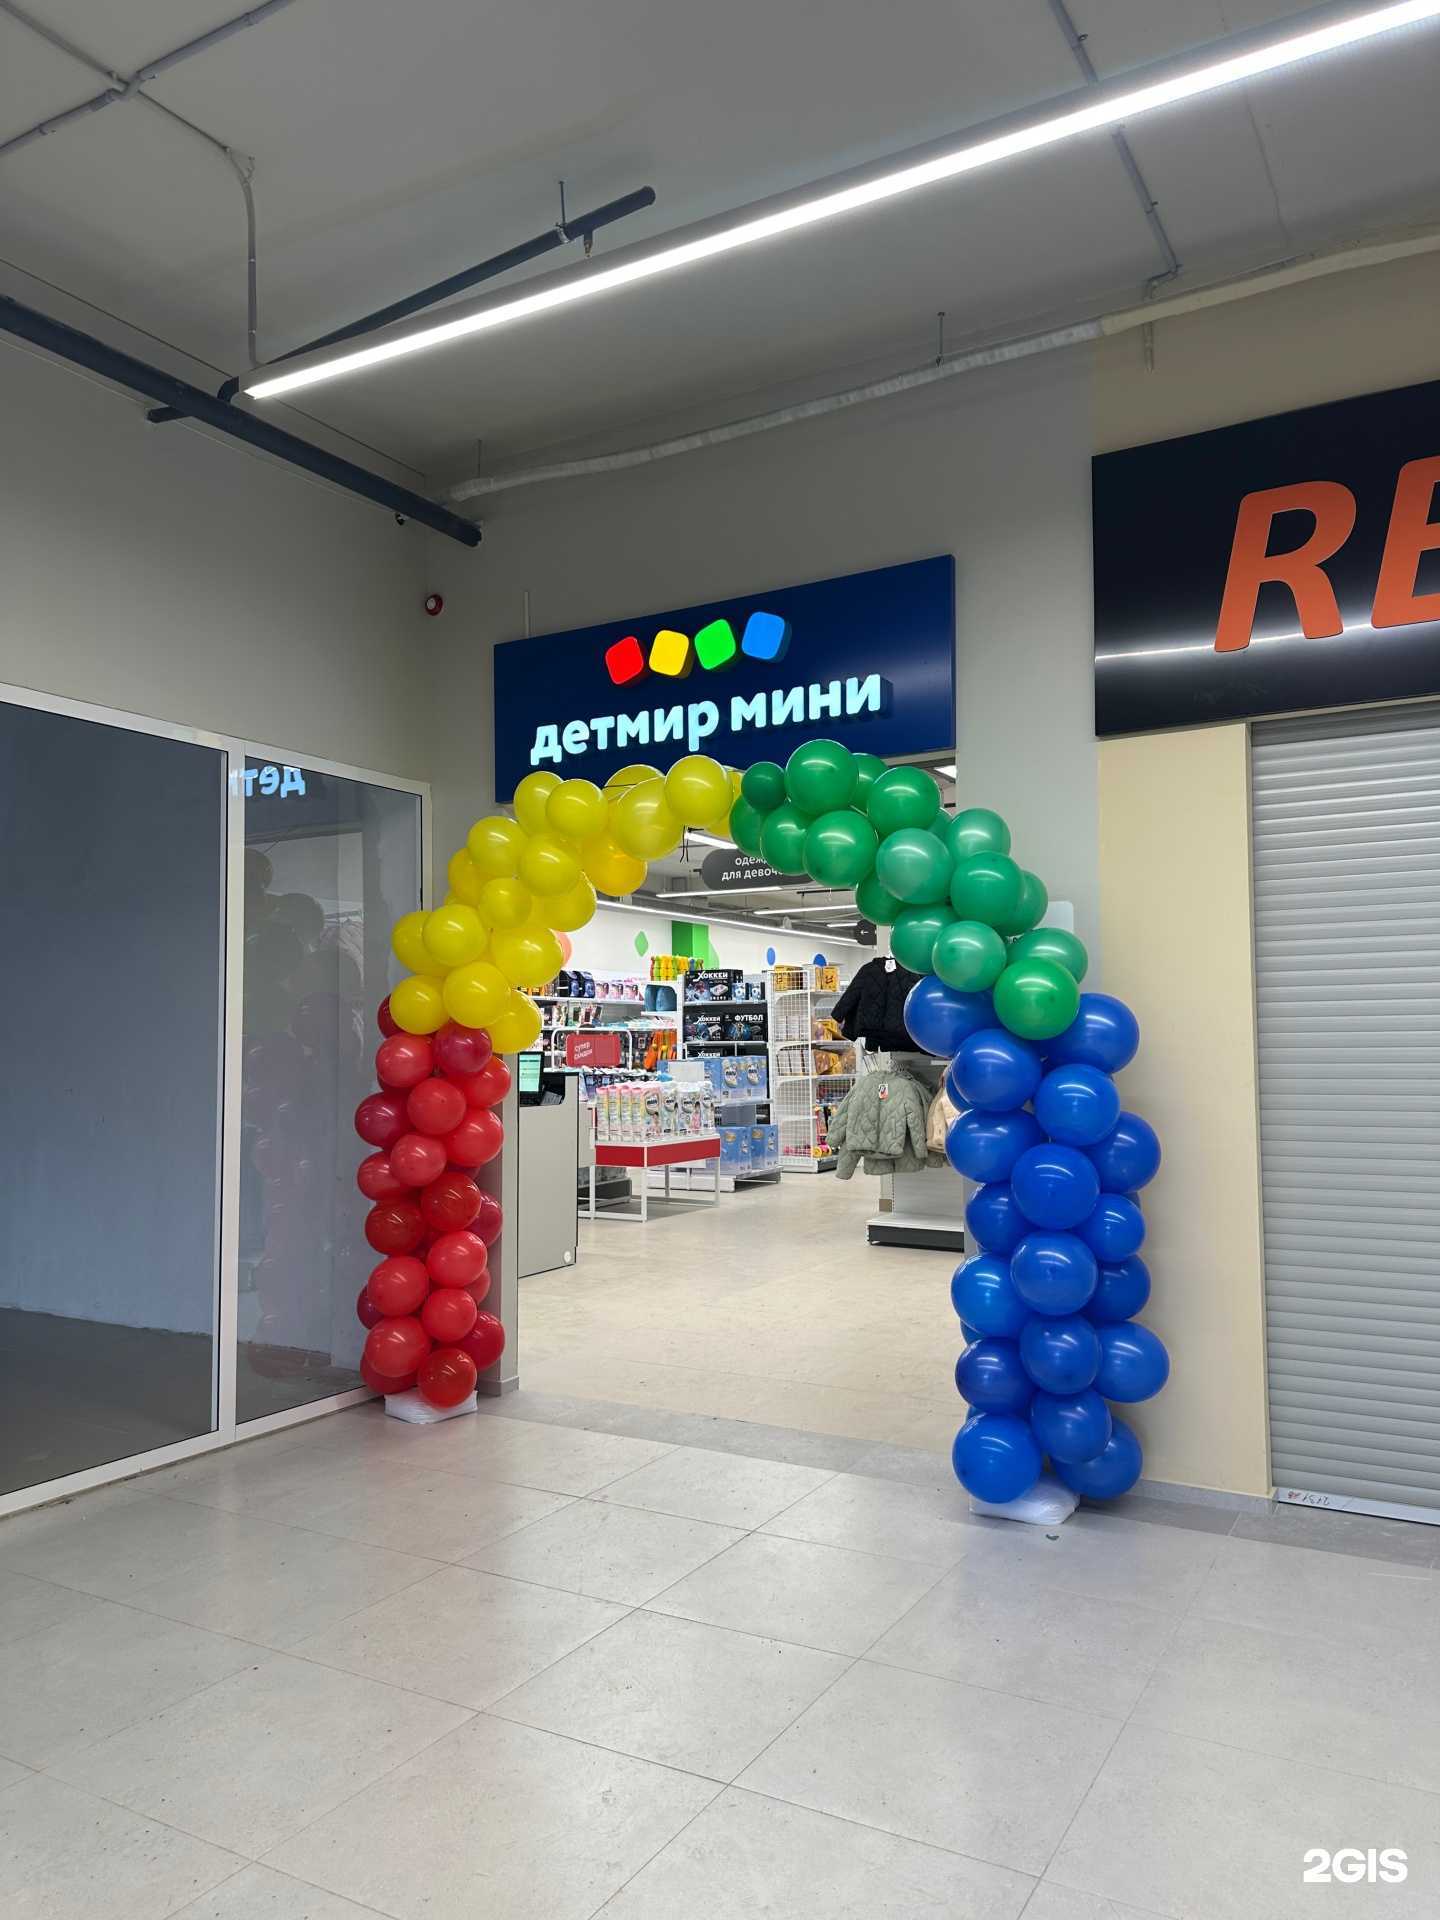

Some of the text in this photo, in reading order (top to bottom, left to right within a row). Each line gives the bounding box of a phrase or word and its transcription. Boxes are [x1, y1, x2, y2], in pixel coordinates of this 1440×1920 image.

[1214, 456, 1440, 653] RE
[530, 673, 882, 766] детмир мини
[721, 871, 742, 881] для
